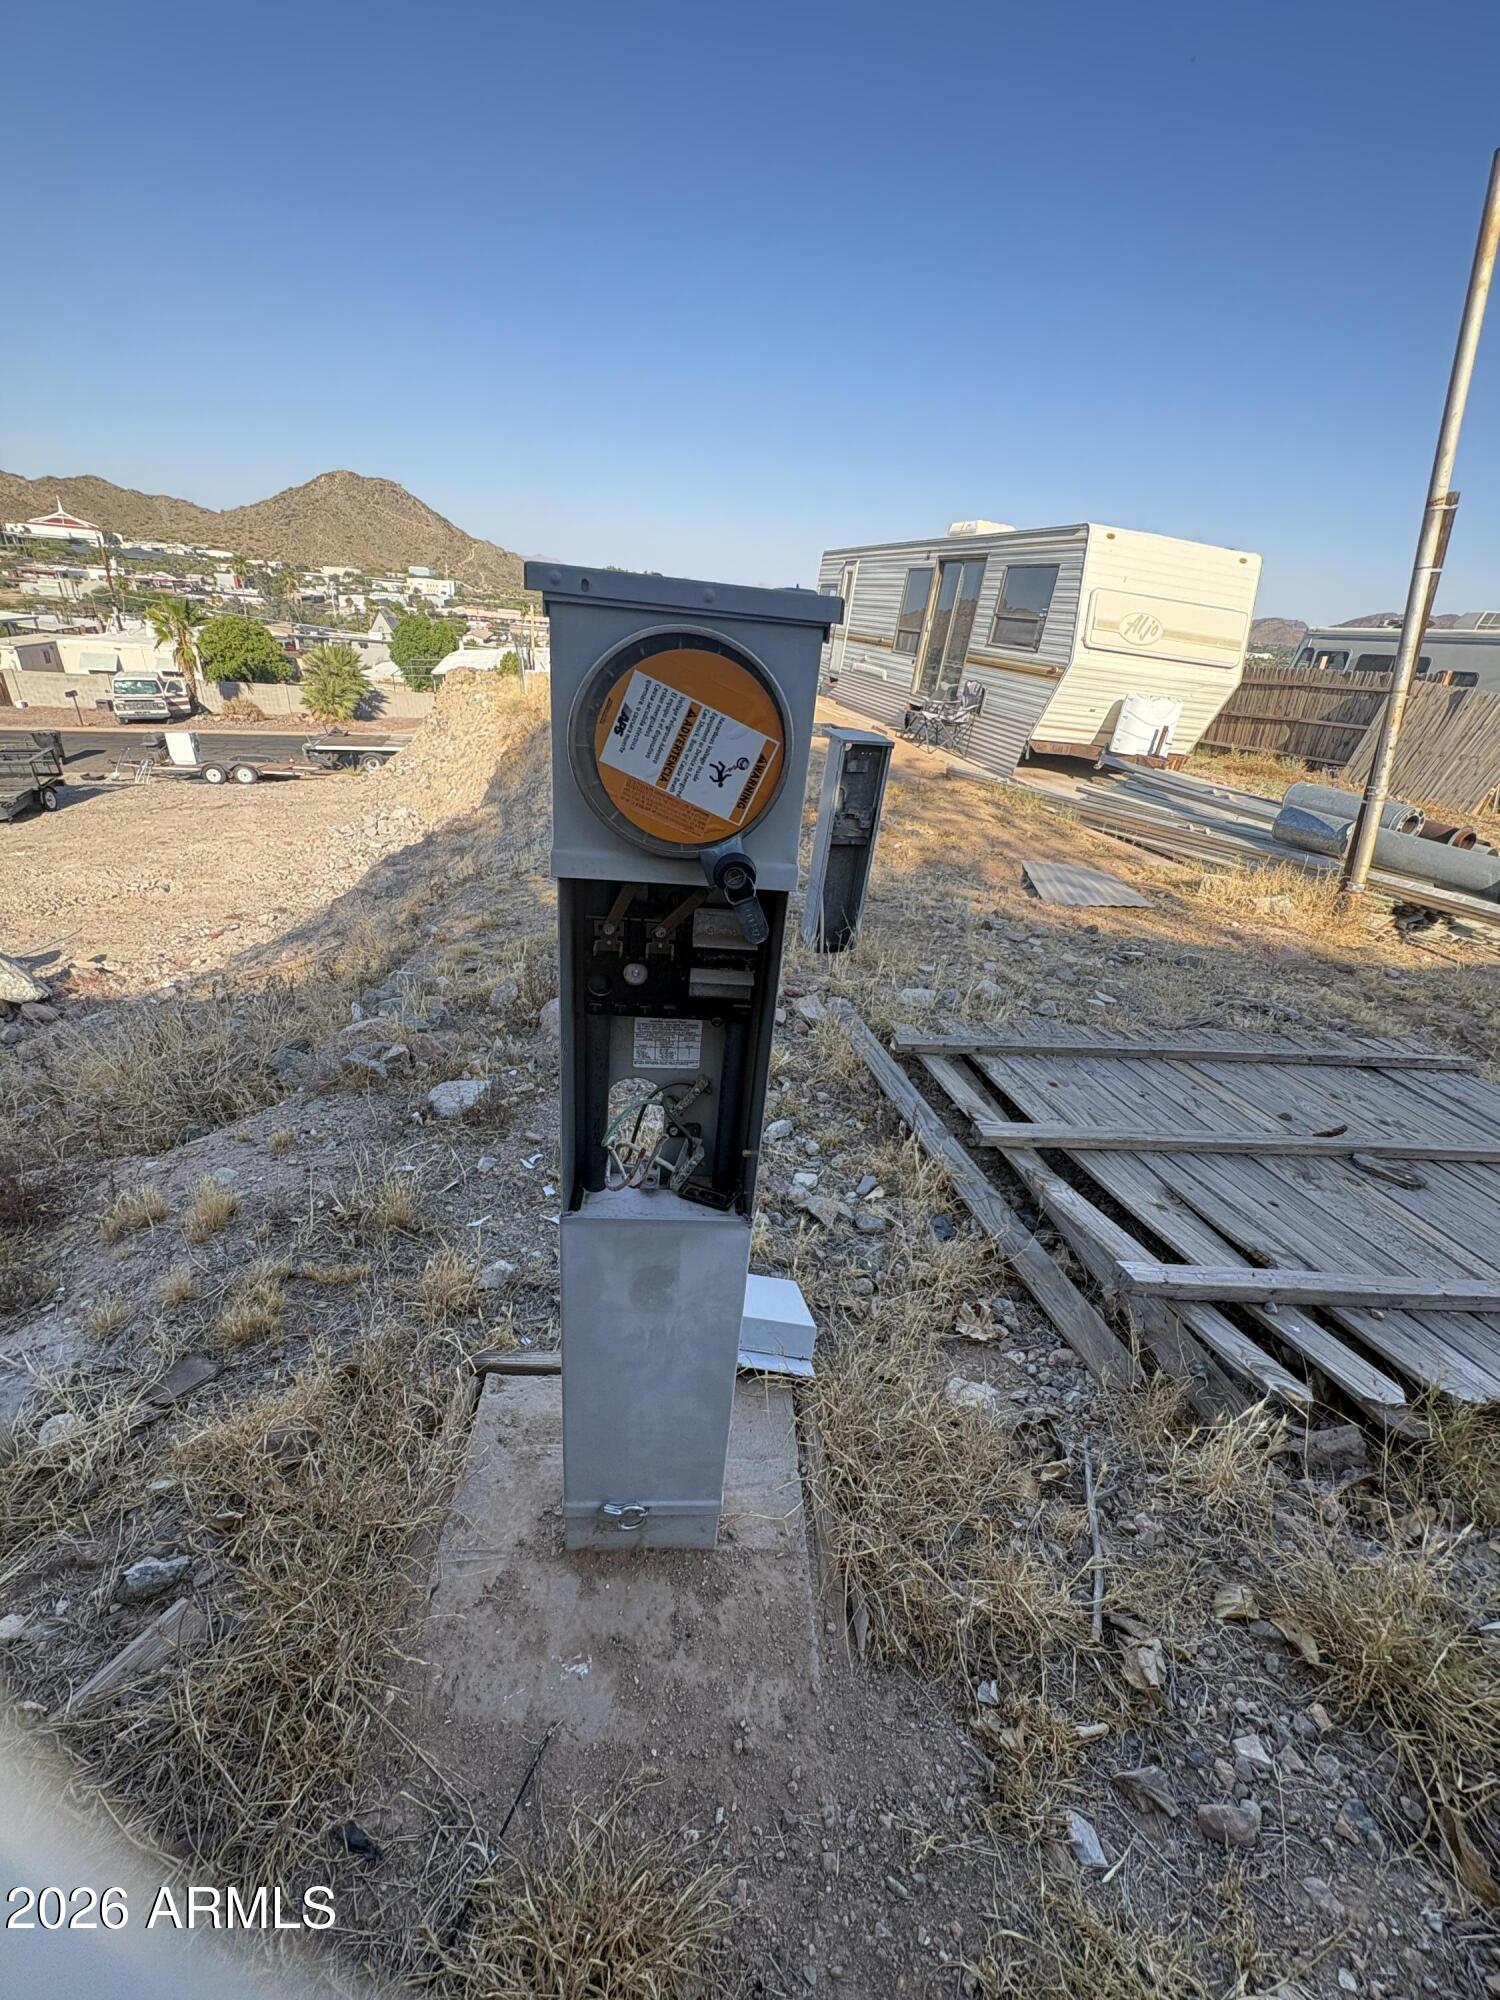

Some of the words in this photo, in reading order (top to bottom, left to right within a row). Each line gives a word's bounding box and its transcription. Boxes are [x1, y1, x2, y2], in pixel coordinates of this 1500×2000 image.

[1123, 614, 1159, 640] Aljo
[612, 710, 630, 737] APS
[699, 711, 717, 742] Equipment
[700, 708, 710, 720] Can
[708, 716, 725, 745] Hazardous
[659, 719, 692, 783] ADVERTENCIA
[689, 748, 701, 767] Device
[698, 744, 712, 765] Voltage
[675, 760, 687, 777] Cause
[668, 776, 680, 793] Death
[674, 771, 691, 798] Energized
[736, 761, 767, 810] WARNING
